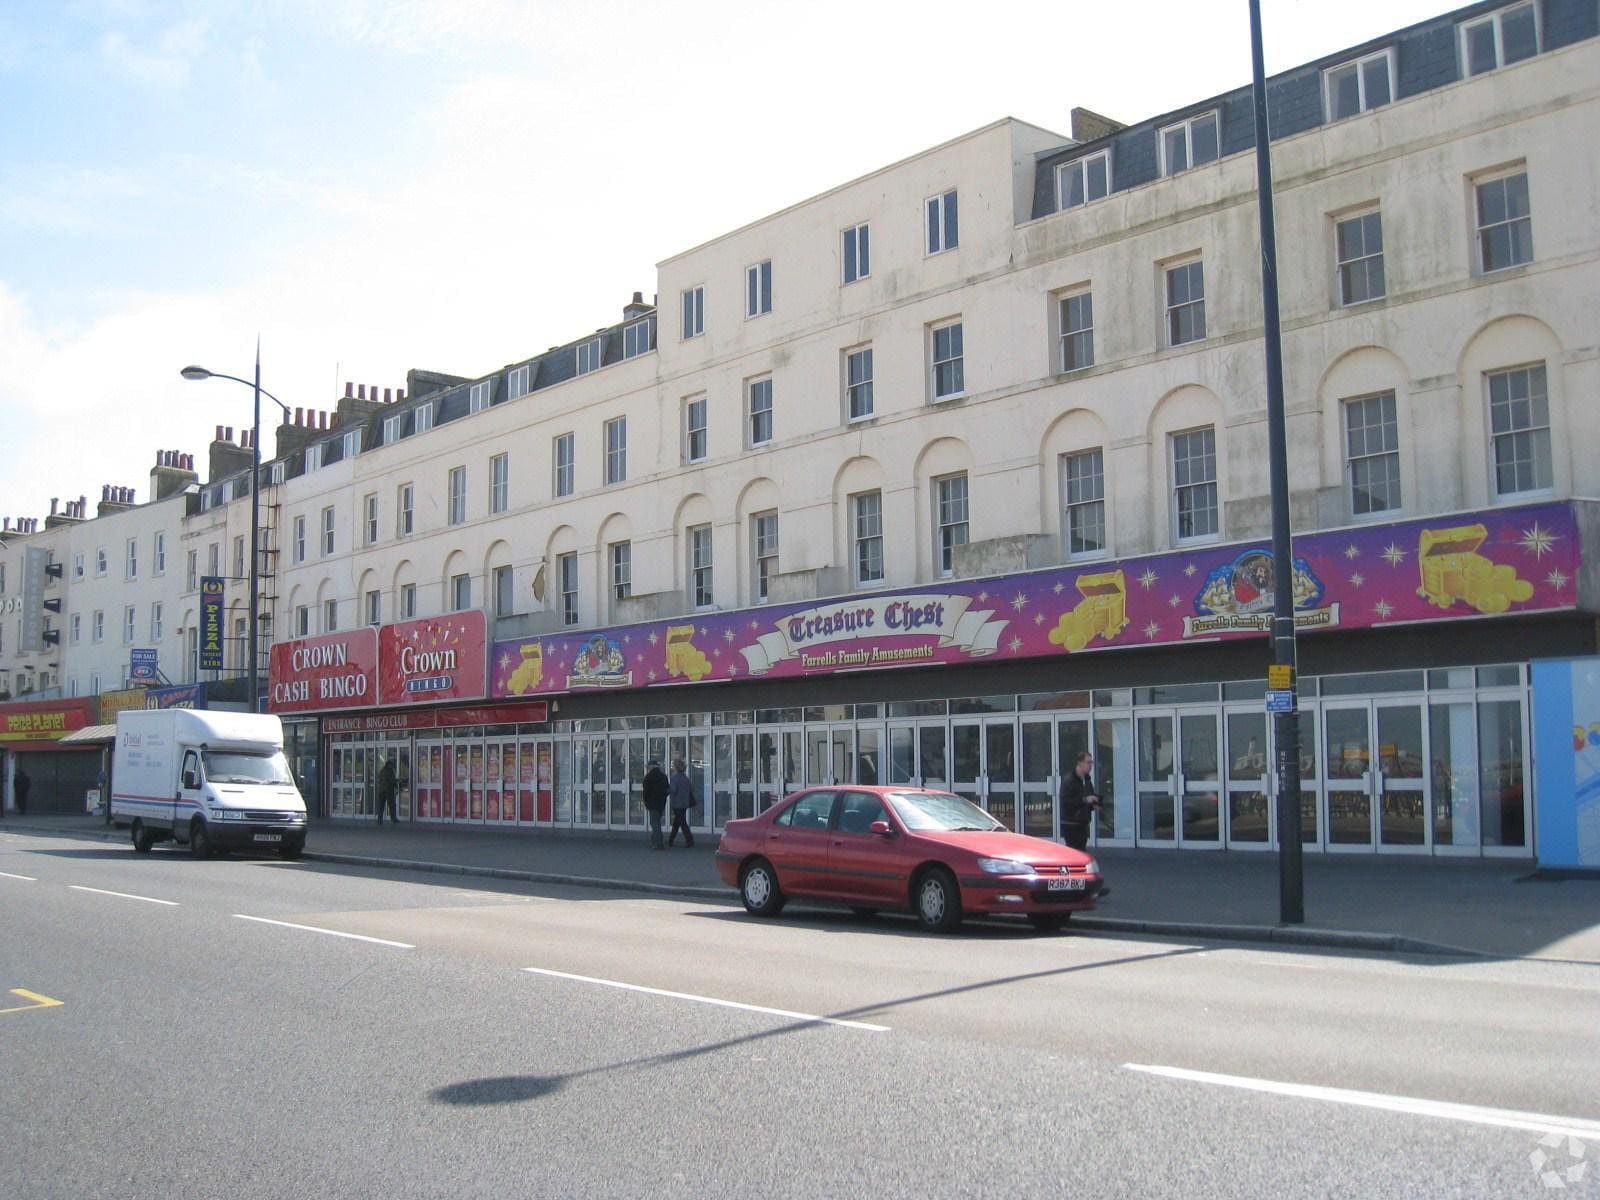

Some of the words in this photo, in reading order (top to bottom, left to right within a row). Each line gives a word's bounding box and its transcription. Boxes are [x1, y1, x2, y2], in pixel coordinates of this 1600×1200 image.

[204, 604, 220, 650] PIZZA
[788, 608, 874, 642] Treasure
[884, 600, 945, 631] Chest
[1231, 614, 1265, 631] Family
[1266, 613, 1330, 629] Aements
[293, 644, 348, 672] CROWN
[401, 646, 457, 675] Crown
[802, 652, 837, 668] Farrells
[838, 647, 870, 665] Family
[872, 643, 933, 661] Amusements
[274, 680, 310, 704] CASH
[320, 673, 368, 700] BINGO
[409, 678, 447, 691] BINGO
[328, 718, 361, 731] ENTRANCE
[366, 715, 389, 729] BINGO
[389, 714, 408, 727] CLUB
